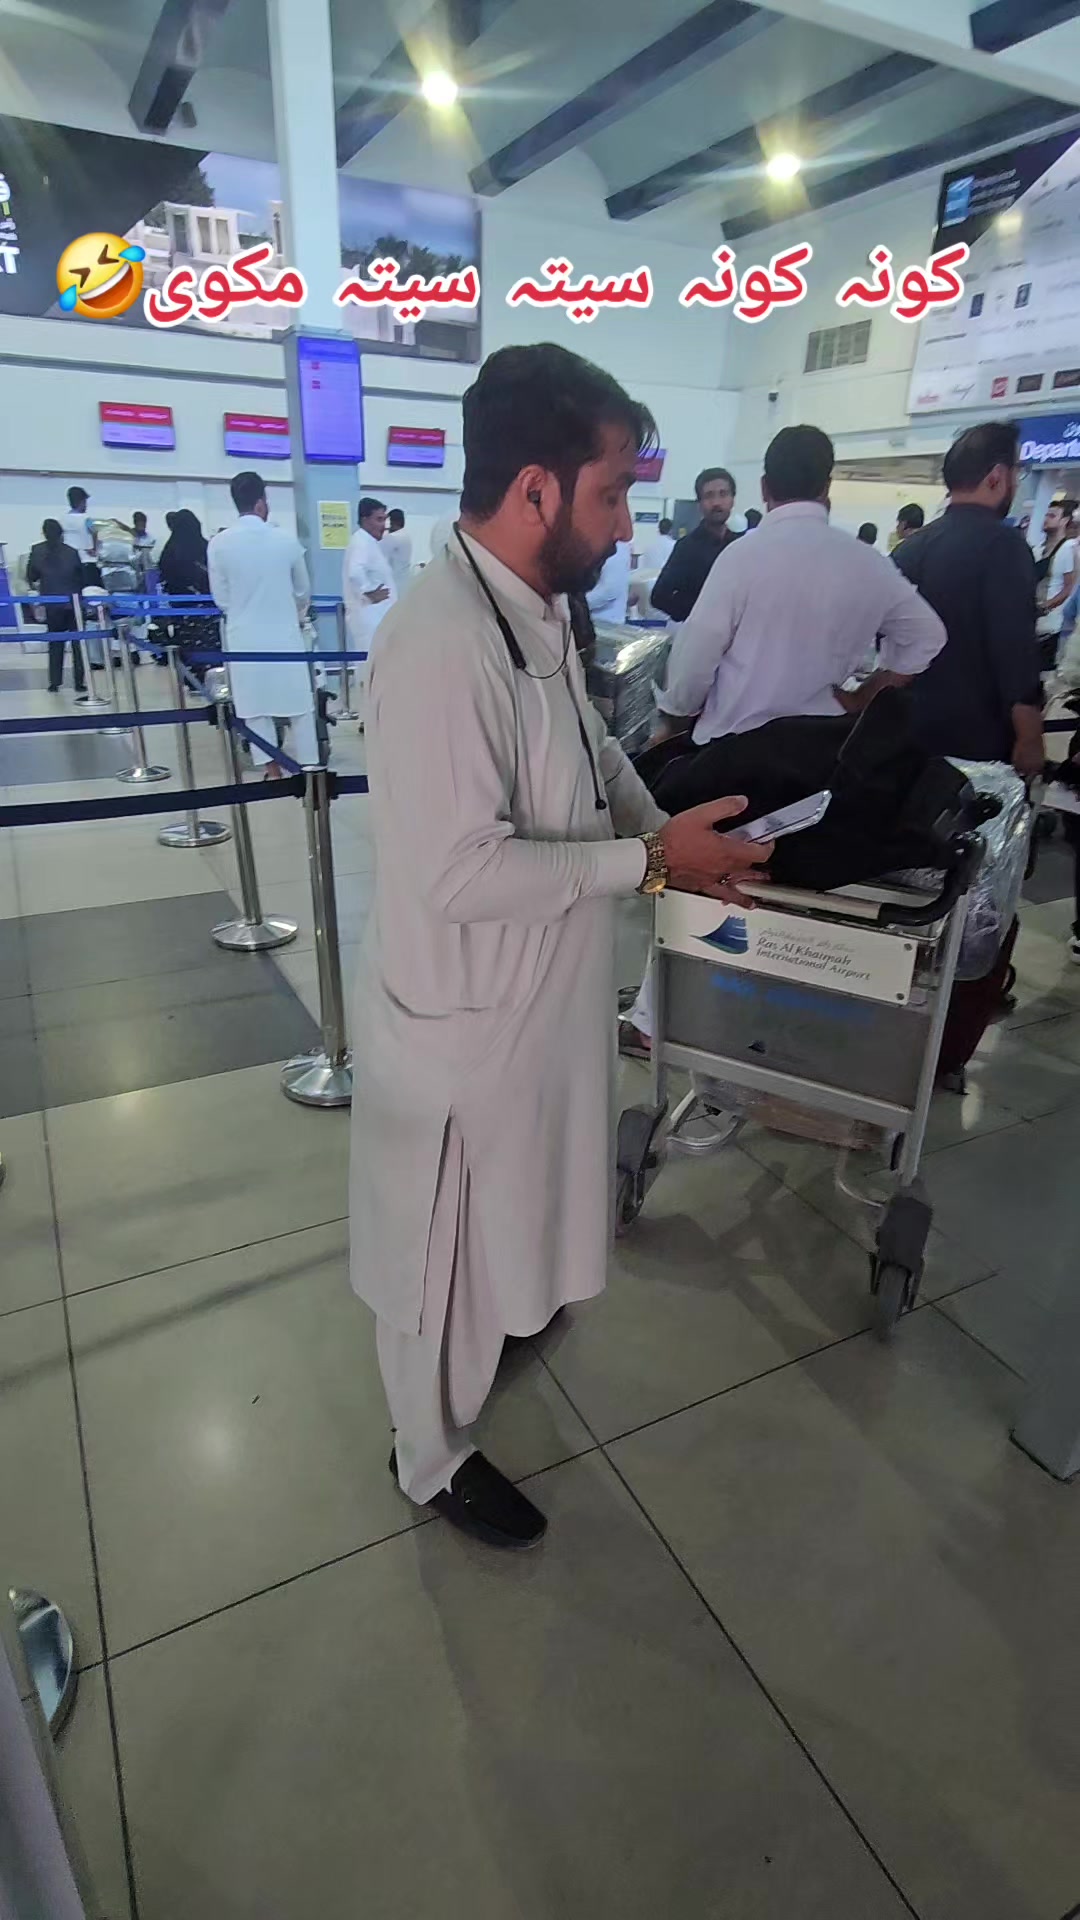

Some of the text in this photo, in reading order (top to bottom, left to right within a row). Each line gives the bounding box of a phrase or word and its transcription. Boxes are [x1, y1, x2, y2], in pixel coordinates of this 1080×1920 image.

[756, 948, 871, 980] International Airport
[757, 936, 778, 950] Ras
[781, 942, 795, 953] Al
[795, 944, 852, 966] Khaimah
